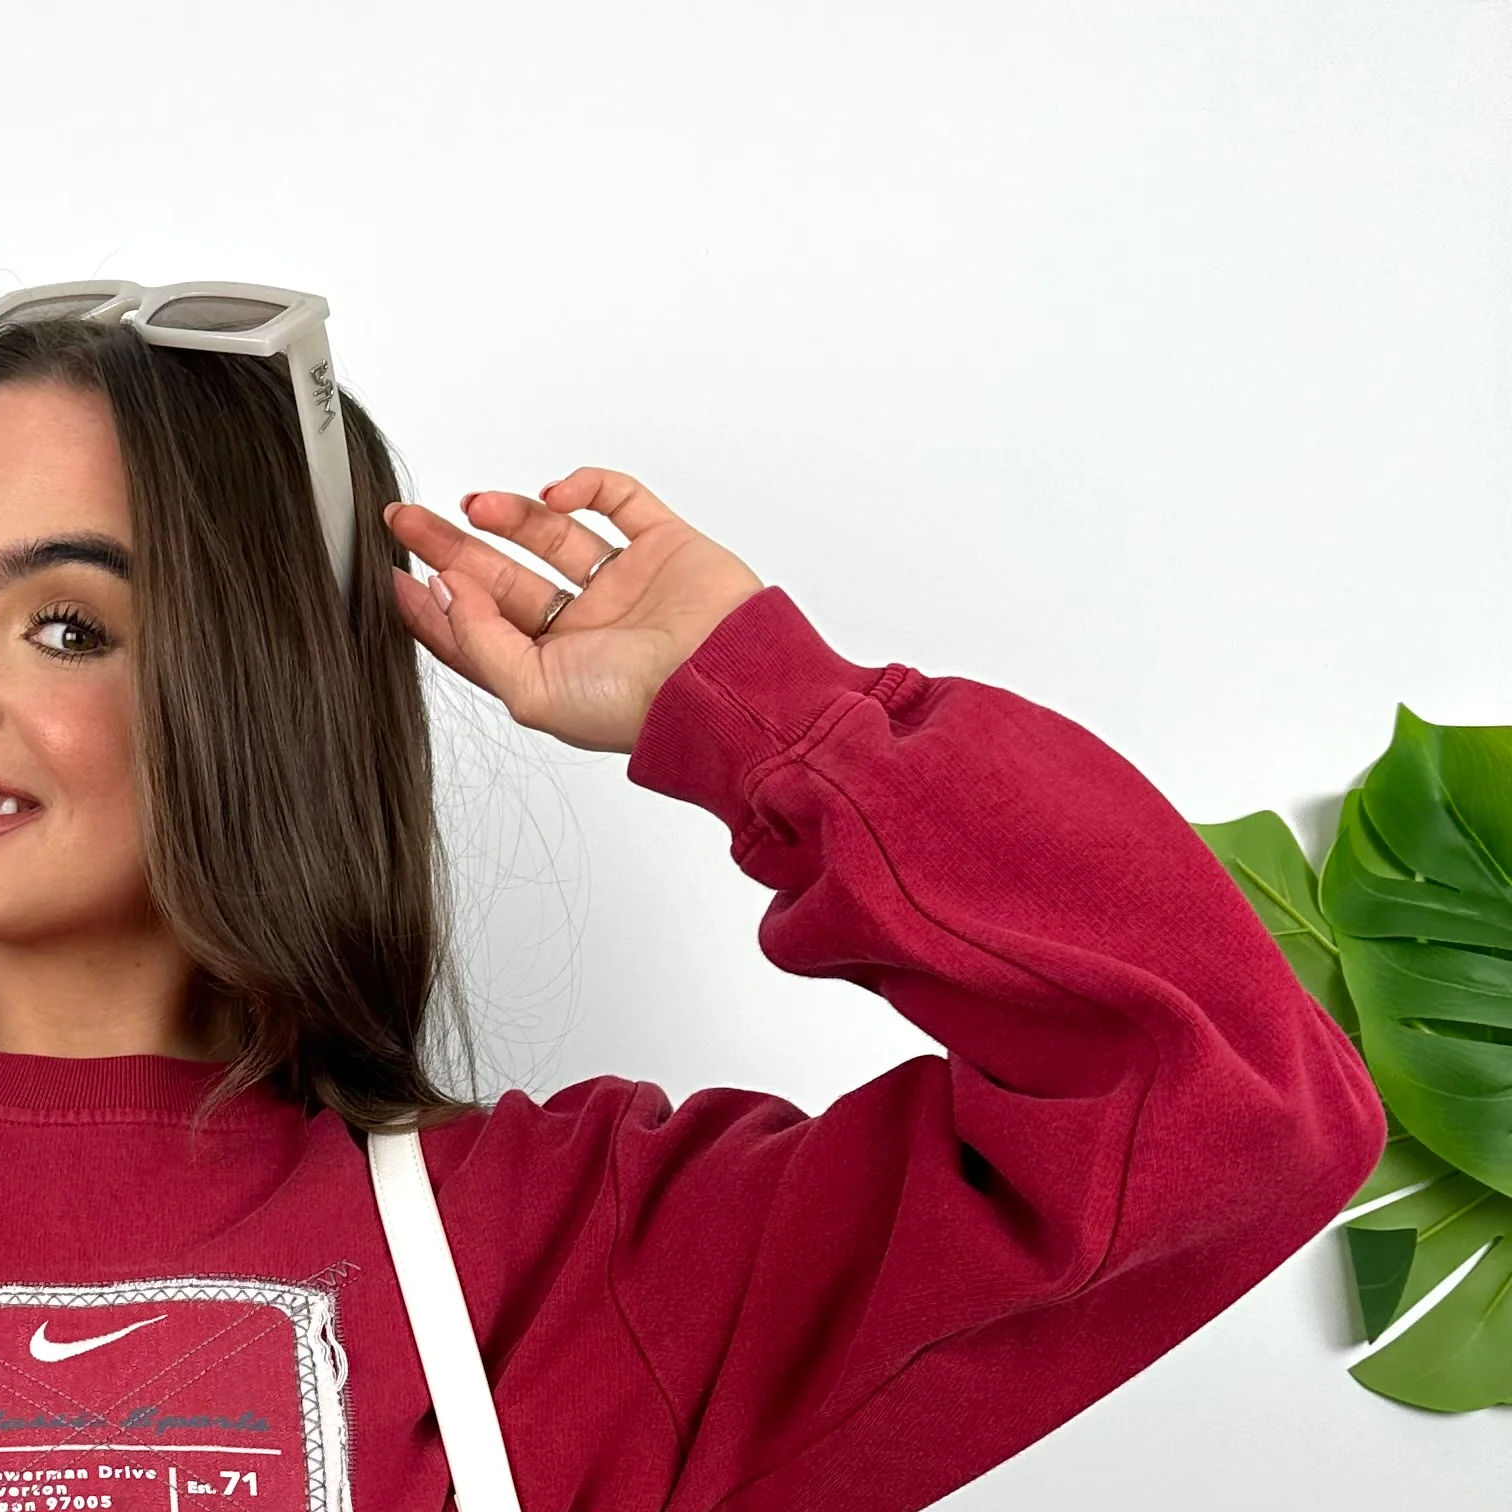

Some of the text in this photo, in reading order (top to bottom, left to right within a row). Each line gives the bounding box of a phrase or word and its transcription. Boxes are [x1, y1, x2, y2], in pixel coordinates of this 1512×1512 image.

[98, 1465, 157, 1480] Drive
[219, 1470, 258, 1497] 71
[46, 1495, 113, 1511] 97005
